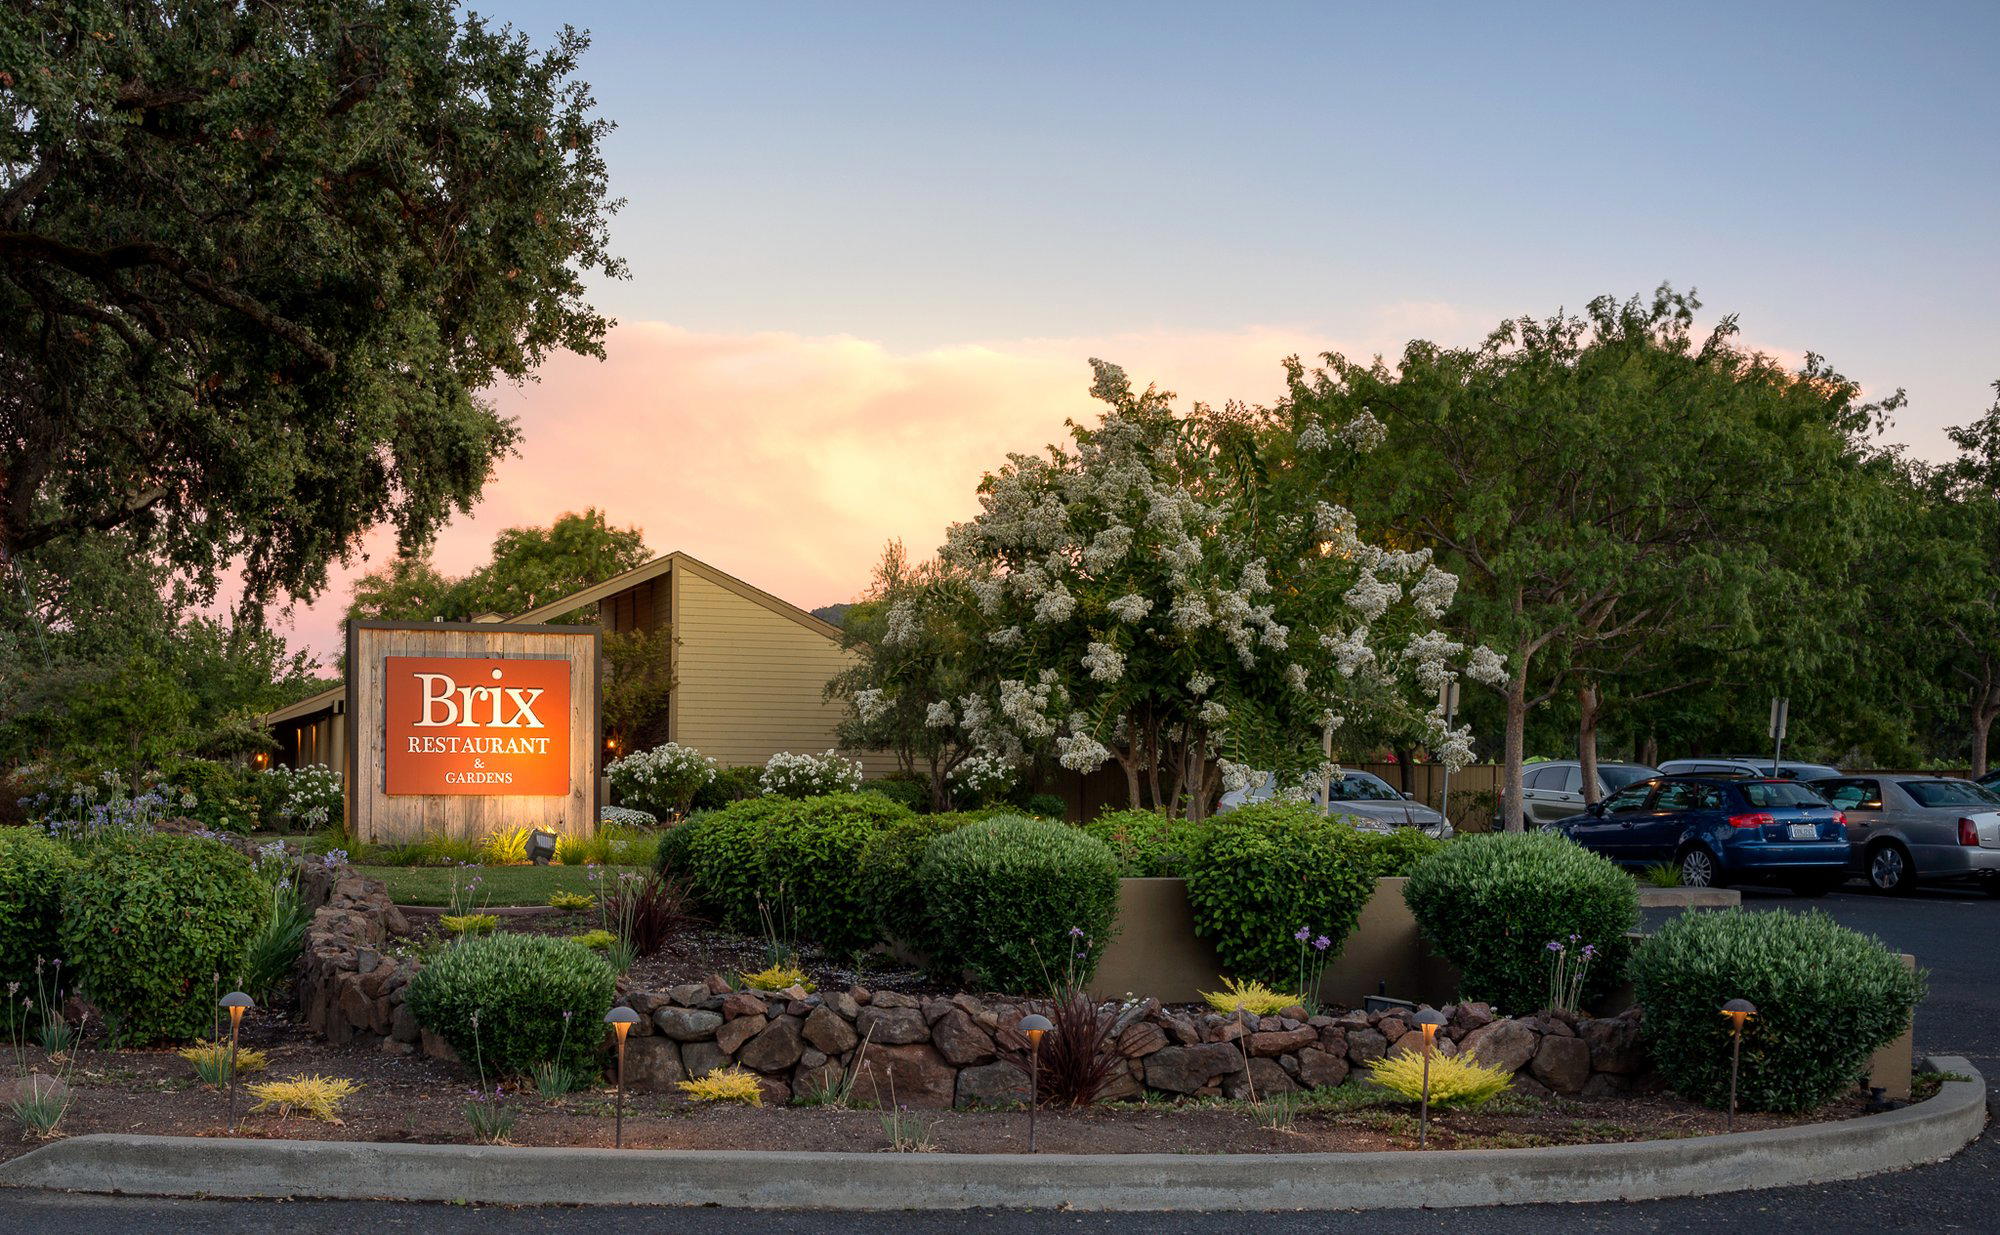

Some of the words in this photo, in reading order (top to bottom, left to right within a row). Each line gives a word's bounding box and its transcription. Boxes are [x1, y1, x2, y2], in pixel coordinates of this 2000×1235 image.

[413, 668, 545, 729] Brix
[407, 736, 550, 755] RESTAURANT
[474, 758, 485, 769] &
[445, 772, 513, 784] GARDENS
